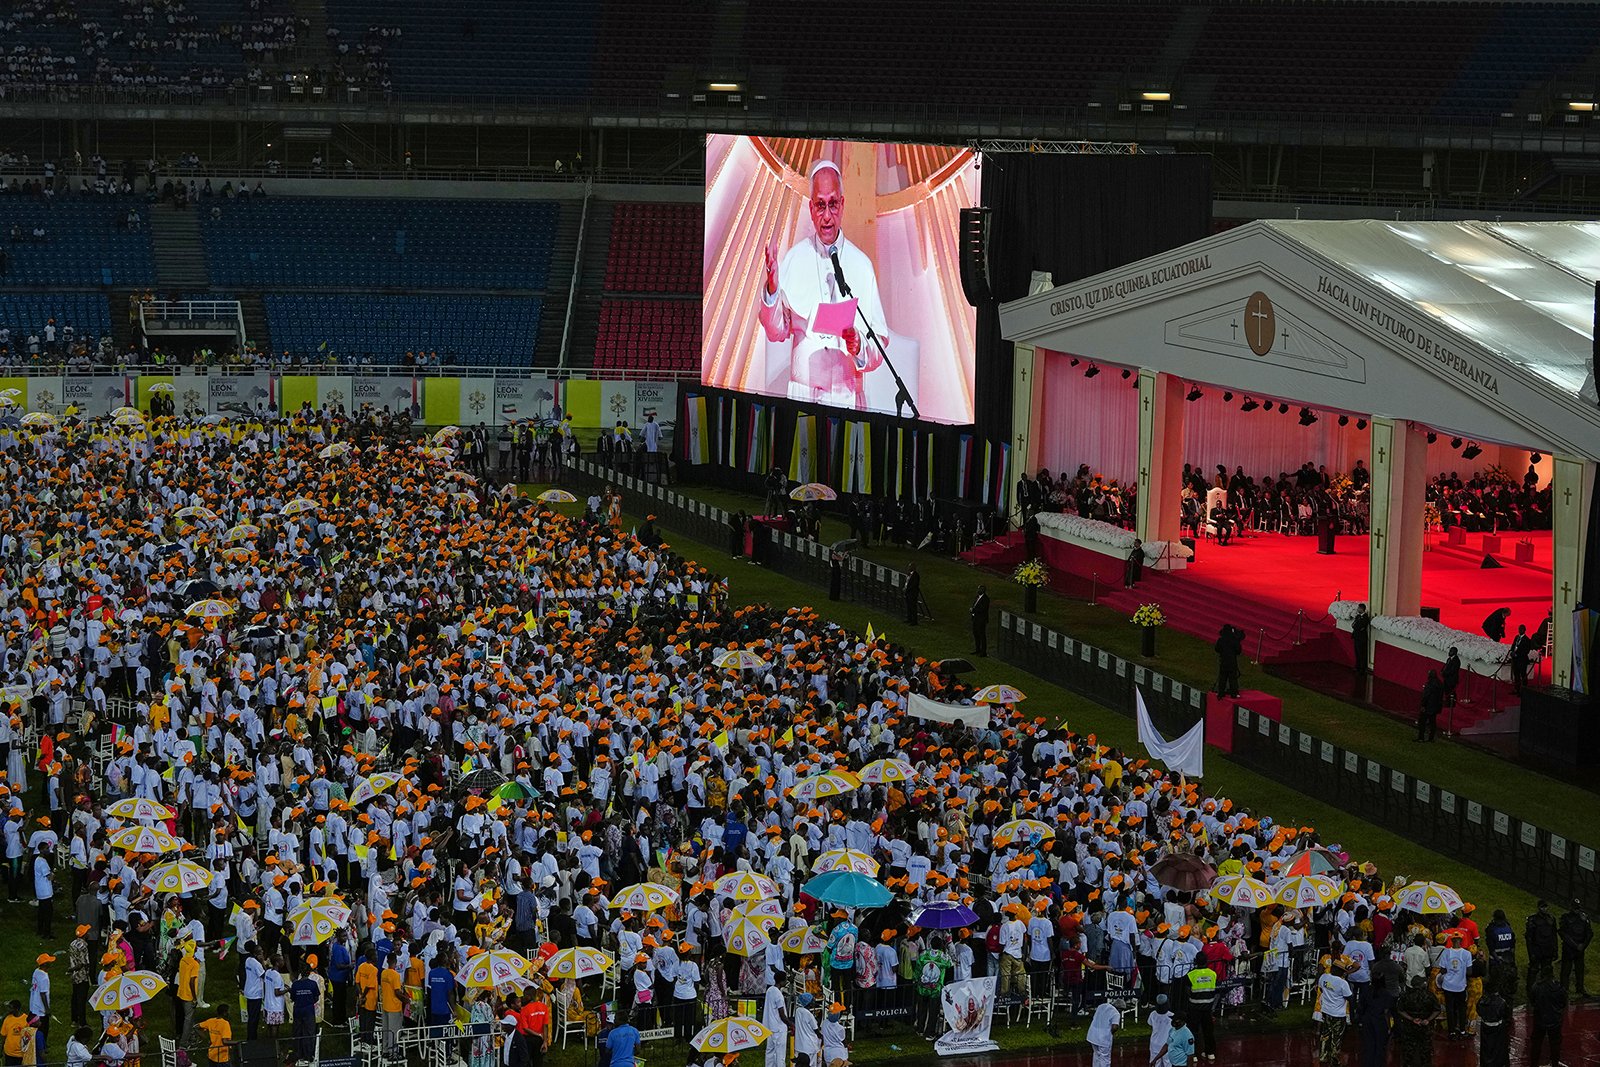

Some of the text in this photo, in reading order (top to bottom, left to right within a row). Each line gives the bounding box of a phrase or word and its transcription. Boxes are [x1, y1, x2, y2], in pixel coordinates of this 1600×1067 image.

[1050, 254, 1212, 317] CRISTO, LUZ DE GUINEA ECUATORIAL
[1317, 275, 1500, 396] HACIA UN FUTURO DE ESPERANZA
[1104, 990, 1136, 998] POLICIA
[875, 1008, 908, 1017] POLICIA
